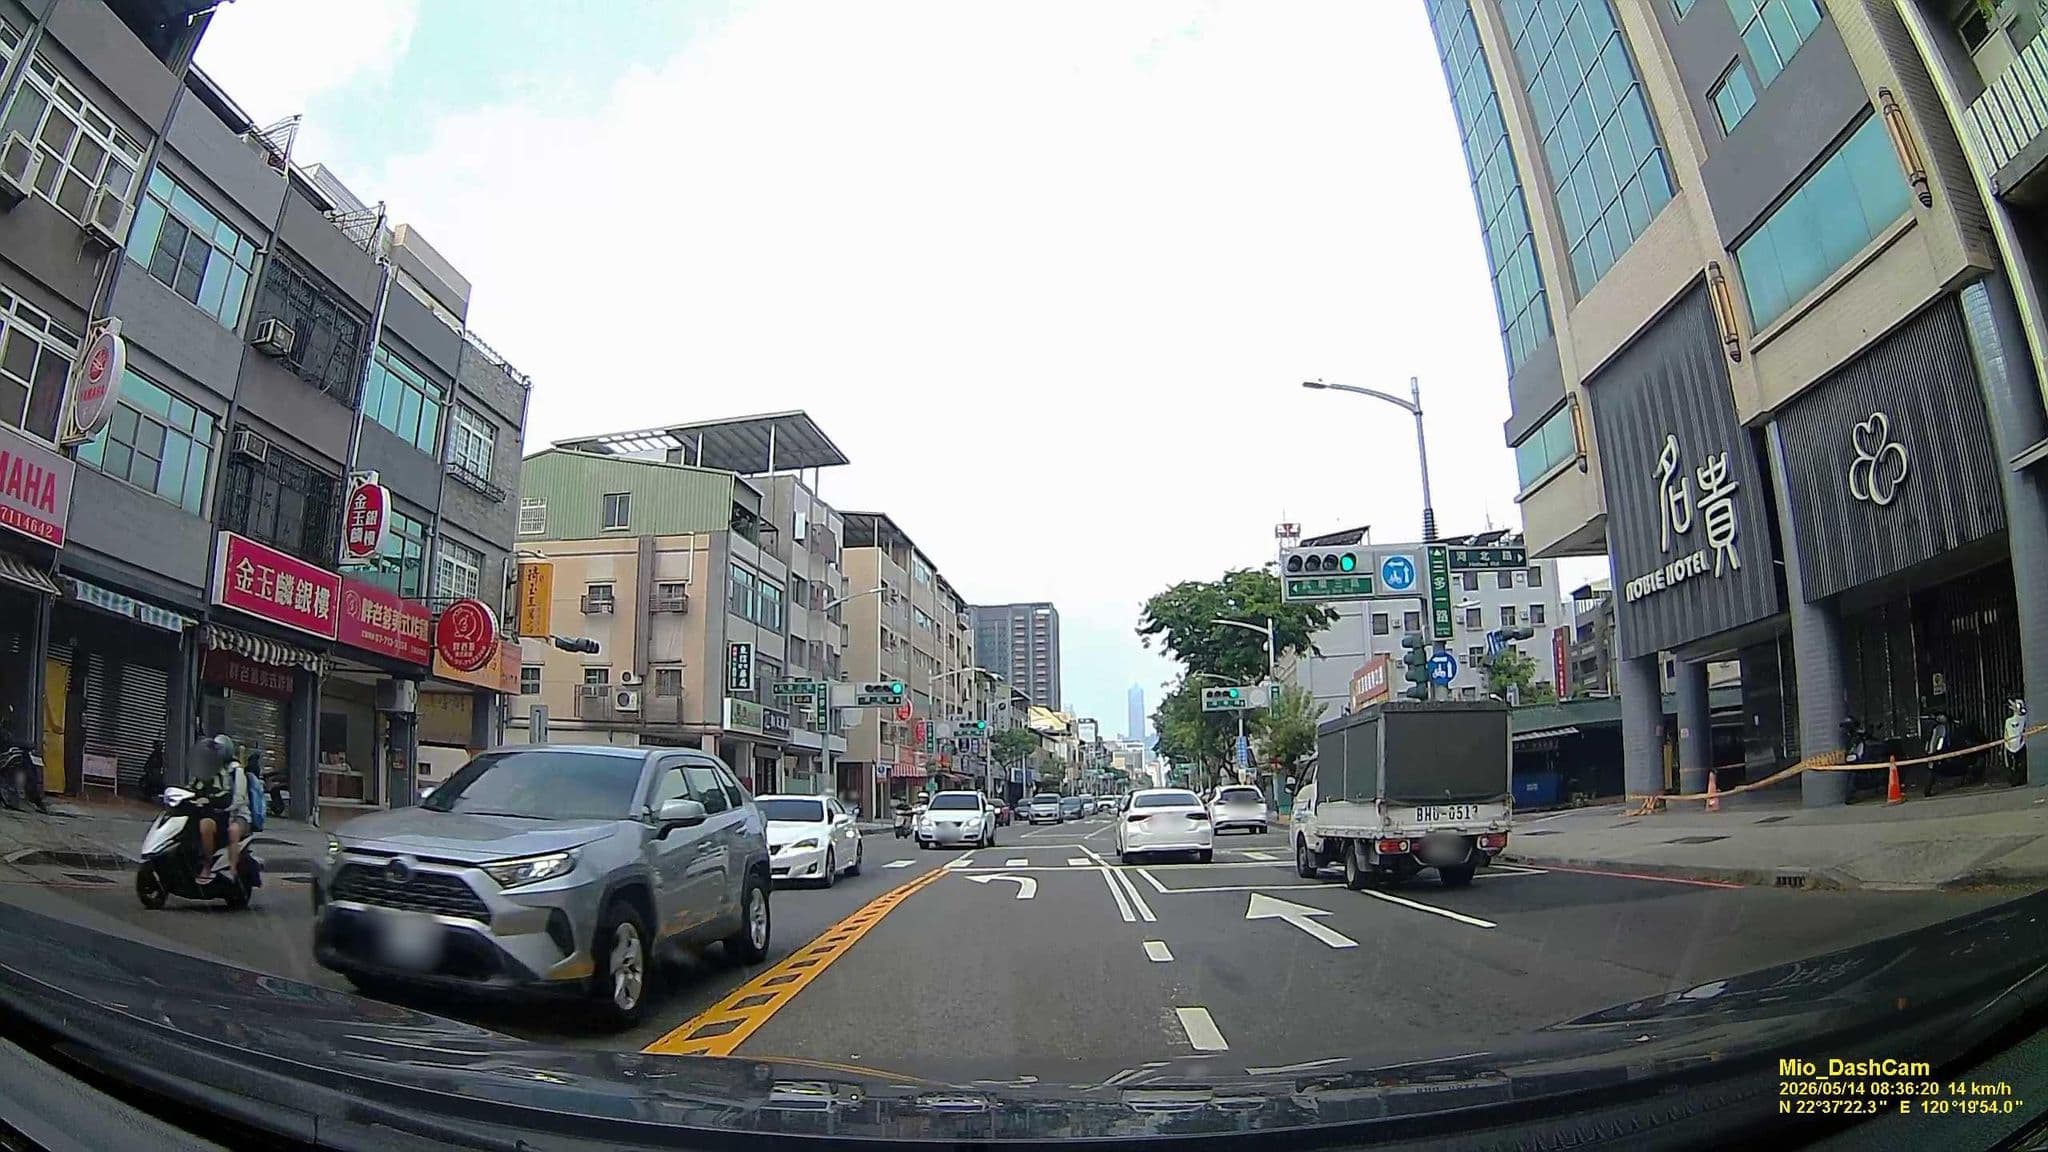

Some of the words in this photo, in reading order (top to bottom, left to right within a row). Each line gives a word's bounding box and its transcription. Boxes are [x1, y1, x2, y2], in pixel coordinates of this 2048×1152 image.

[234, 556, 331, 620] 金玉麟銀樓
[1432, 560, 1449, 622] 三多一路
[1665, 549, 1711, 587] HOTEL
